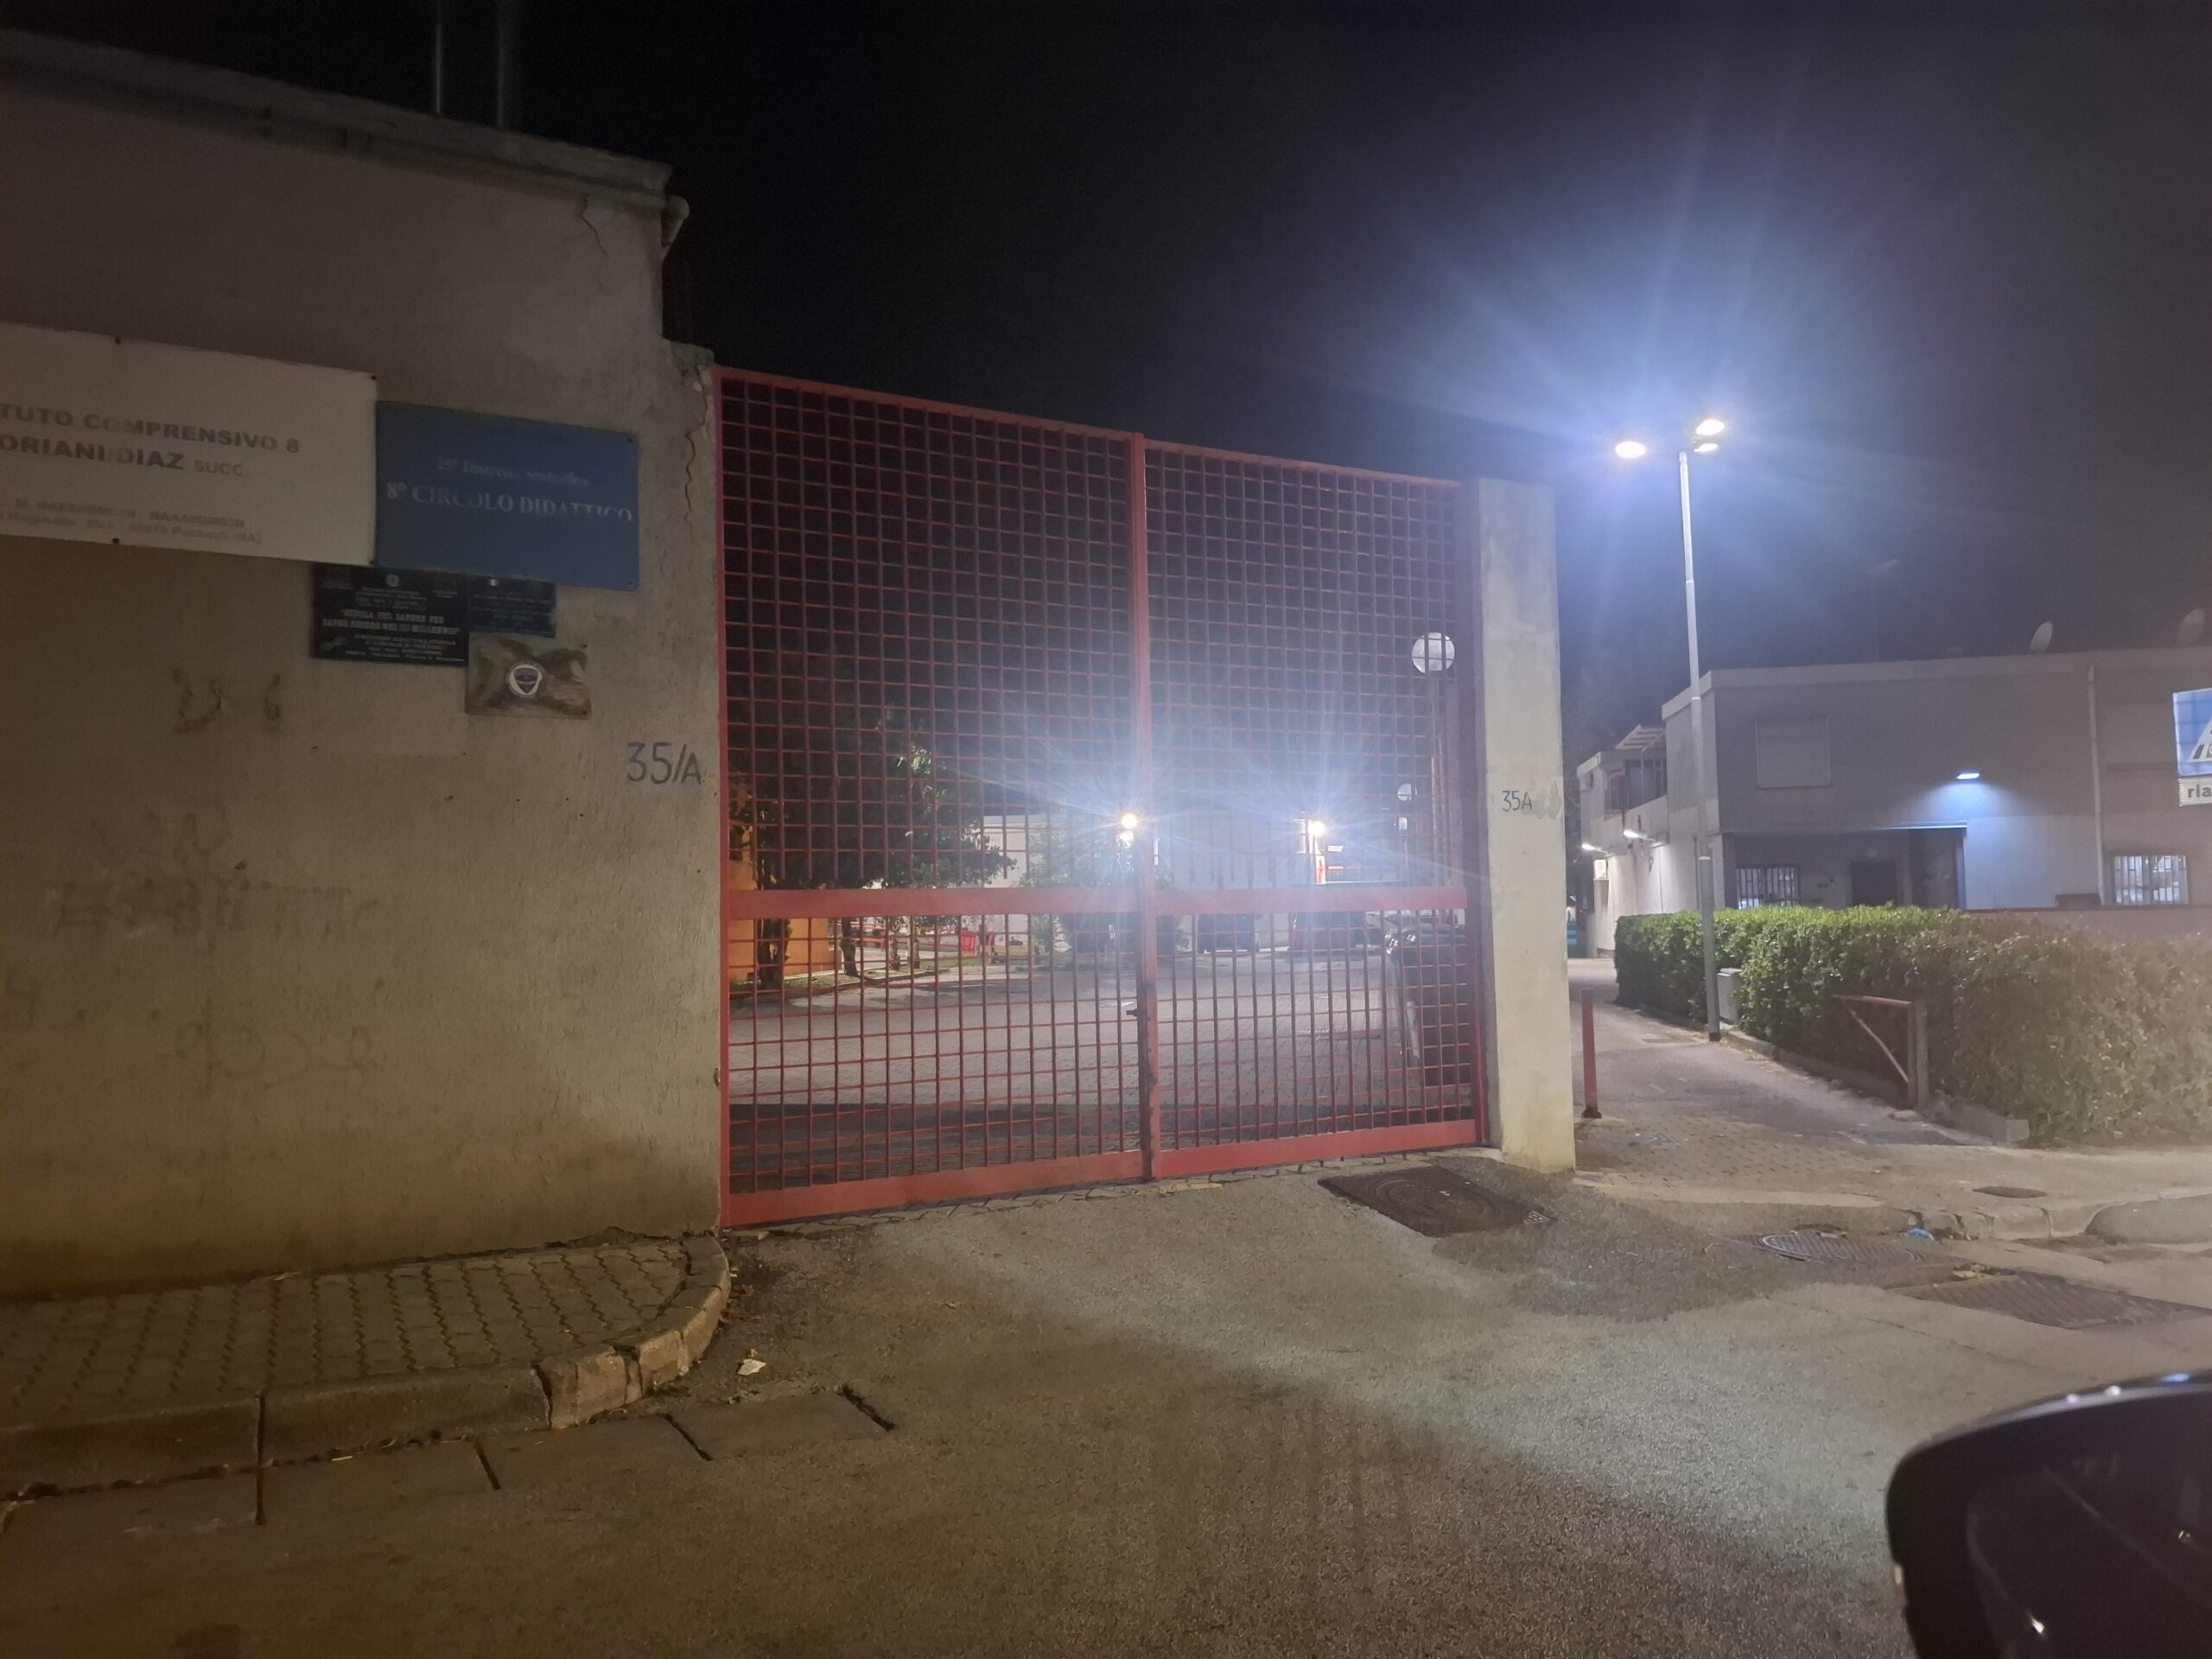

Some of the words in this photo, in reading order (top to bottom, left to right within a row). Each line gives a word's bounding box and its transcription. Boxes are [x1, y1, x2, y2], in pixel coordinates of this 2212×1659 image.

[83, 413, 277, 451] COMPRENSIVO
[285, 437, 300, 454] 8
[411, 484, 514, 512] CIRCOLO
[626, 741, 702, 785] 35/A
[1501, 790, 1533, 812] 35A
